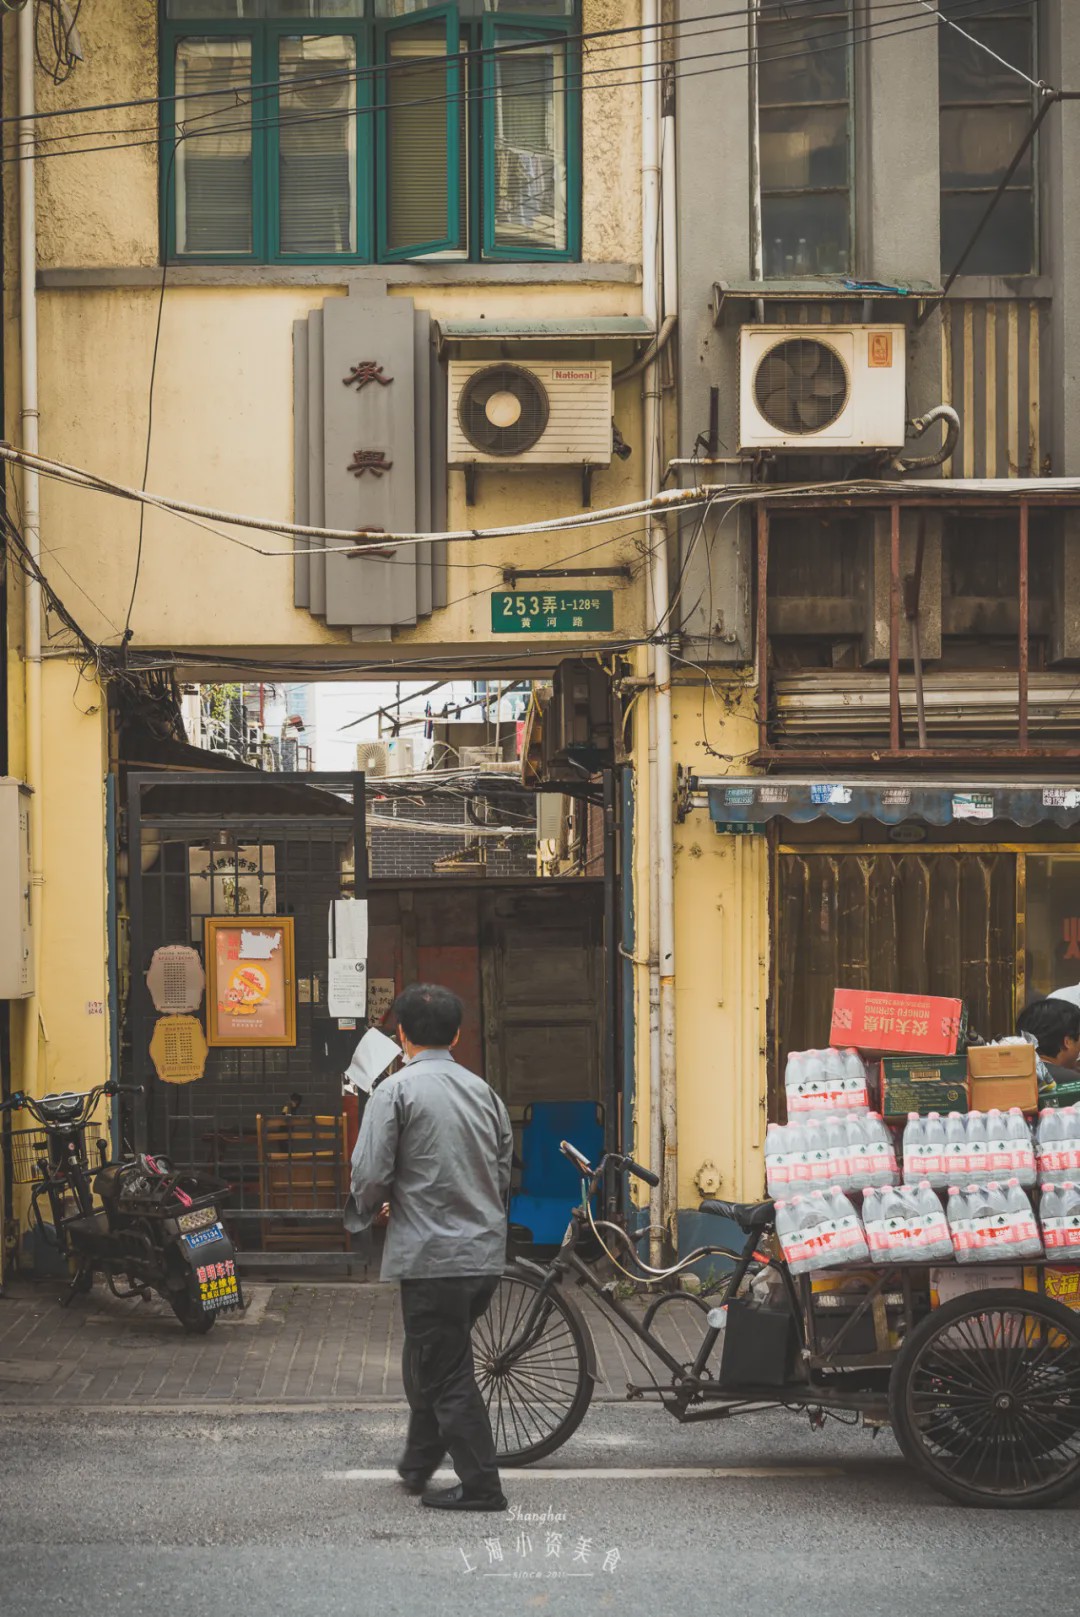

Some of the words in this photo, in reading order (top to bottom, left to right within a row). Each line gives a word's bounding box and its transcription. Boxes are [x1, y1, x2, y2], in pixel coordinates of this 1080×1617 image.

[555, 370, 593, 379] National
[521, 616, 583, 628] 黄河路
[865, 1005, 895, 1016] SPRING
[897, 1008, 930, 1019] NONGFU
[864, 1015, 929, 1036] 农夫山泉
